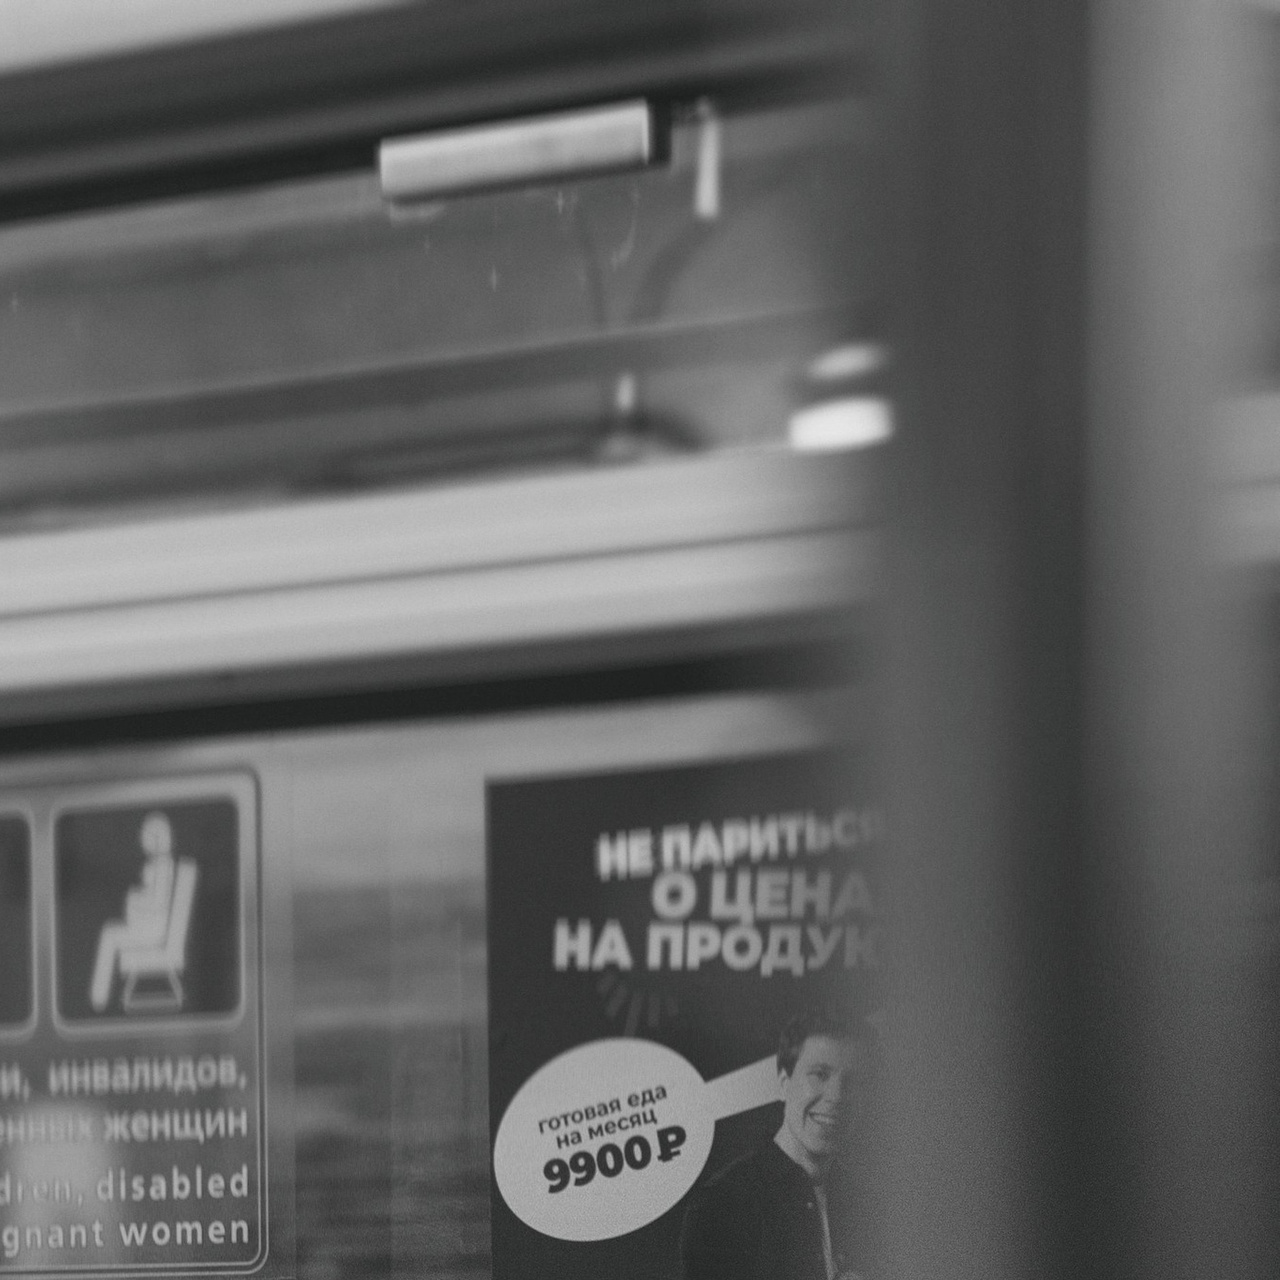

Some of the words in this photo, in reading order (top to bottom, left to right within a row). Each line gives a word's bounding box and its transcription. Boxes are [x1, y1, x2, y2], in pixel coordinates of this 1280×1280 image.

[596, 830, 654, 881] НЕ
[652, 872, 697, 919] О
[710, 868, 875, 928] ЦЕНА
[553, 918, 633, 971] НА
[647, 920, 883, 977] ПРОДУК
[48, 1055, 247, 1096] инвалидов,
[104, 1108, 248, 1144] женщин
[538, 1098, 622, 1135] готовая
[627, 1085, 667, 1107] еда
[556, 1131, 582, 1149] на
[588, 1108, 658, 1140] месяц
[96, 1164, 248, 1201] disabled
[120, 1219, 248, 1246] women
